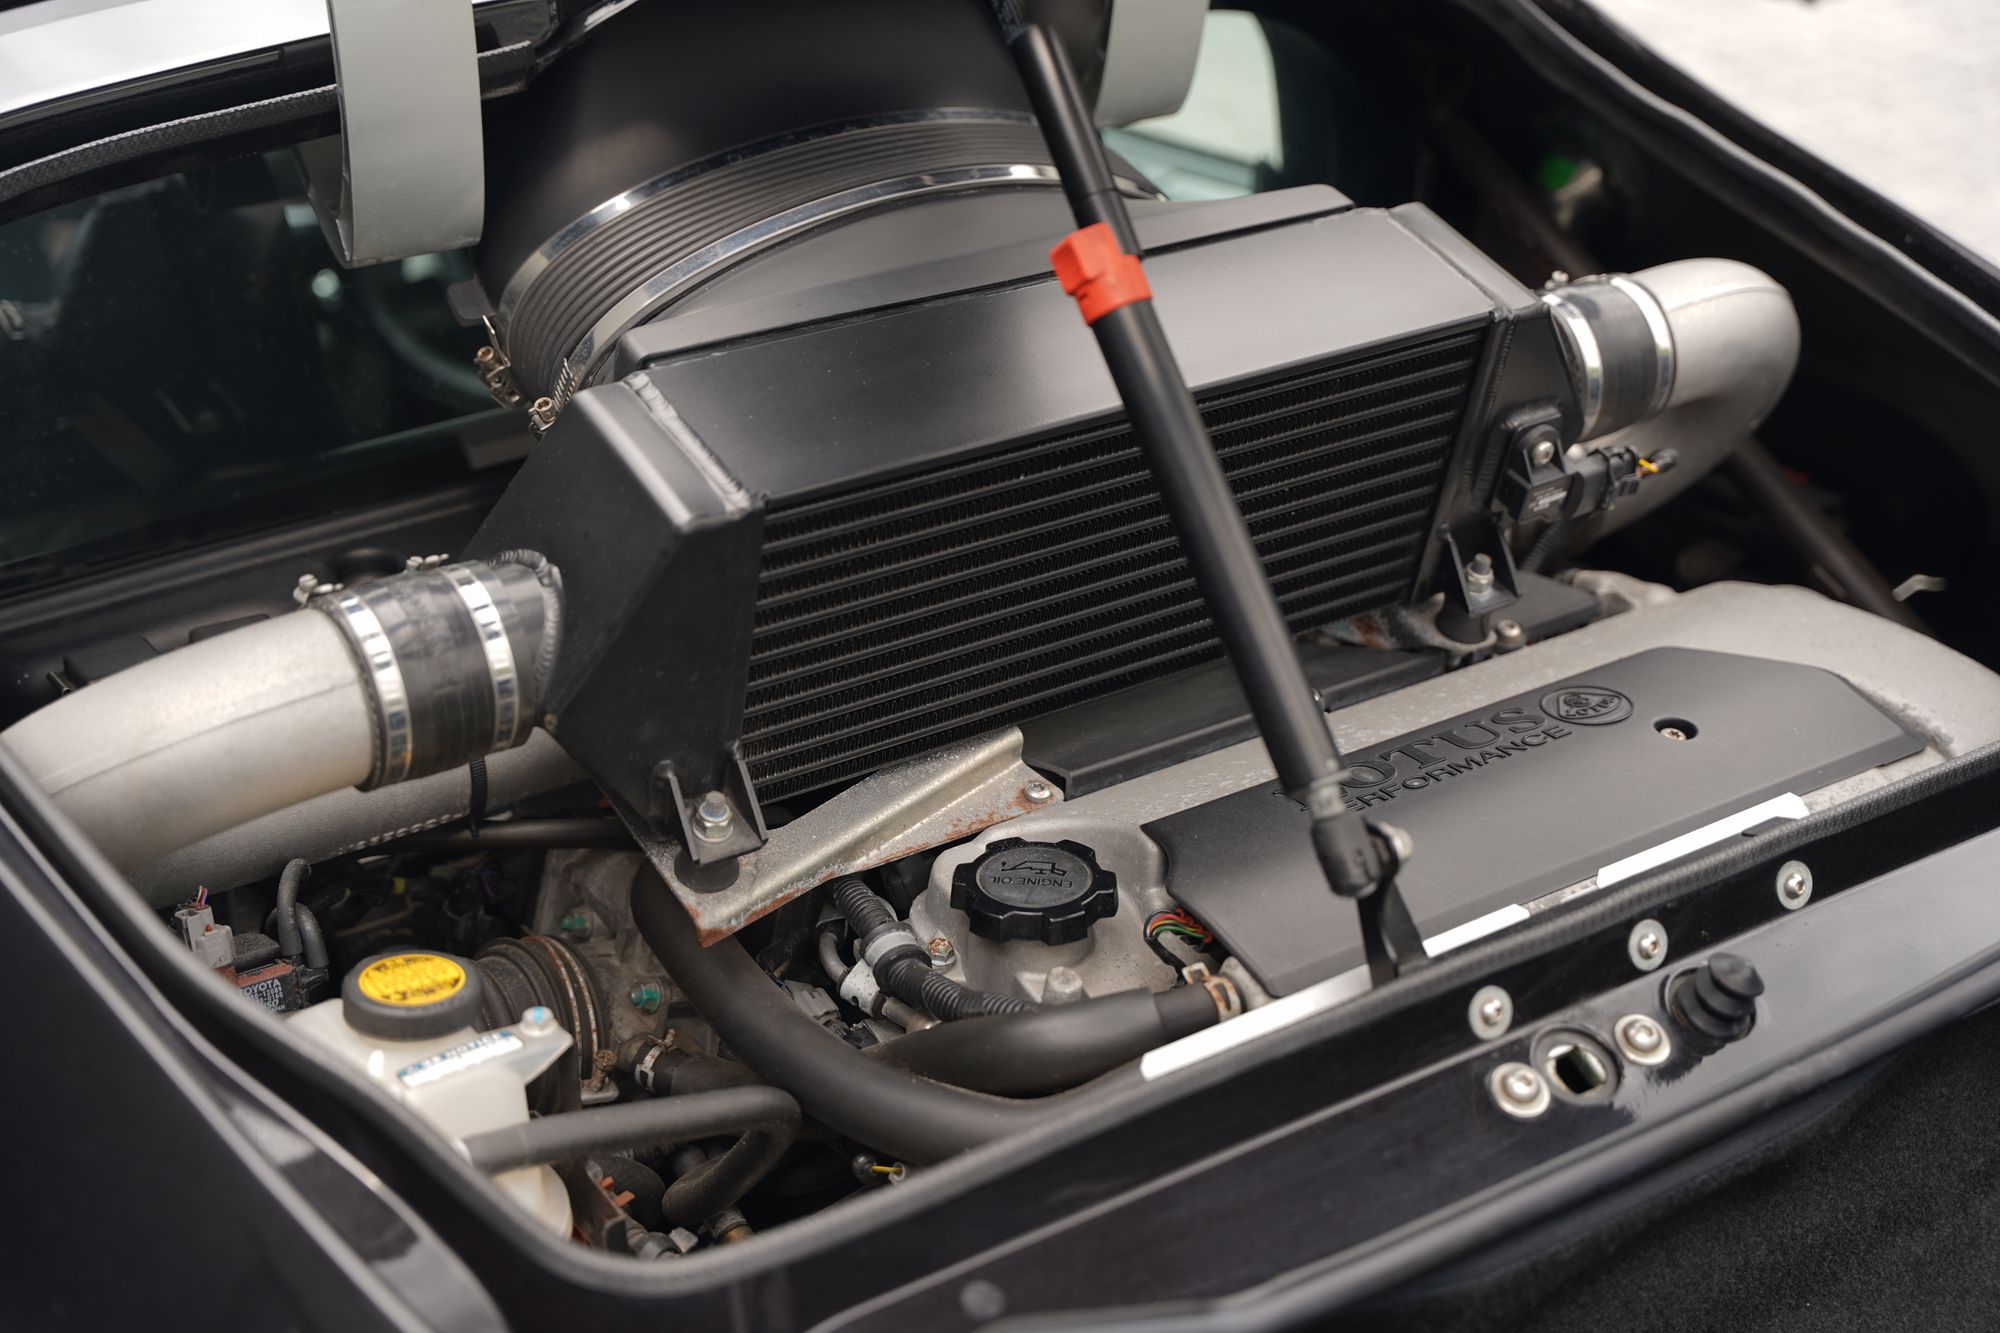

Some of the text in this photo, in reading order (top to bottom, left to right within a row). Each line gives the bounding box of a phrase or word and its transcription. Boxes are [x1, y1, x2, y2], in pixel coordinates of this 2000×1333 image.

[1273, 707, 1547, 812] OTUS
[1344, 725, 1573, 811] ERFORMANCE
[989, 876, 1073, 888] ENGINE OIL
